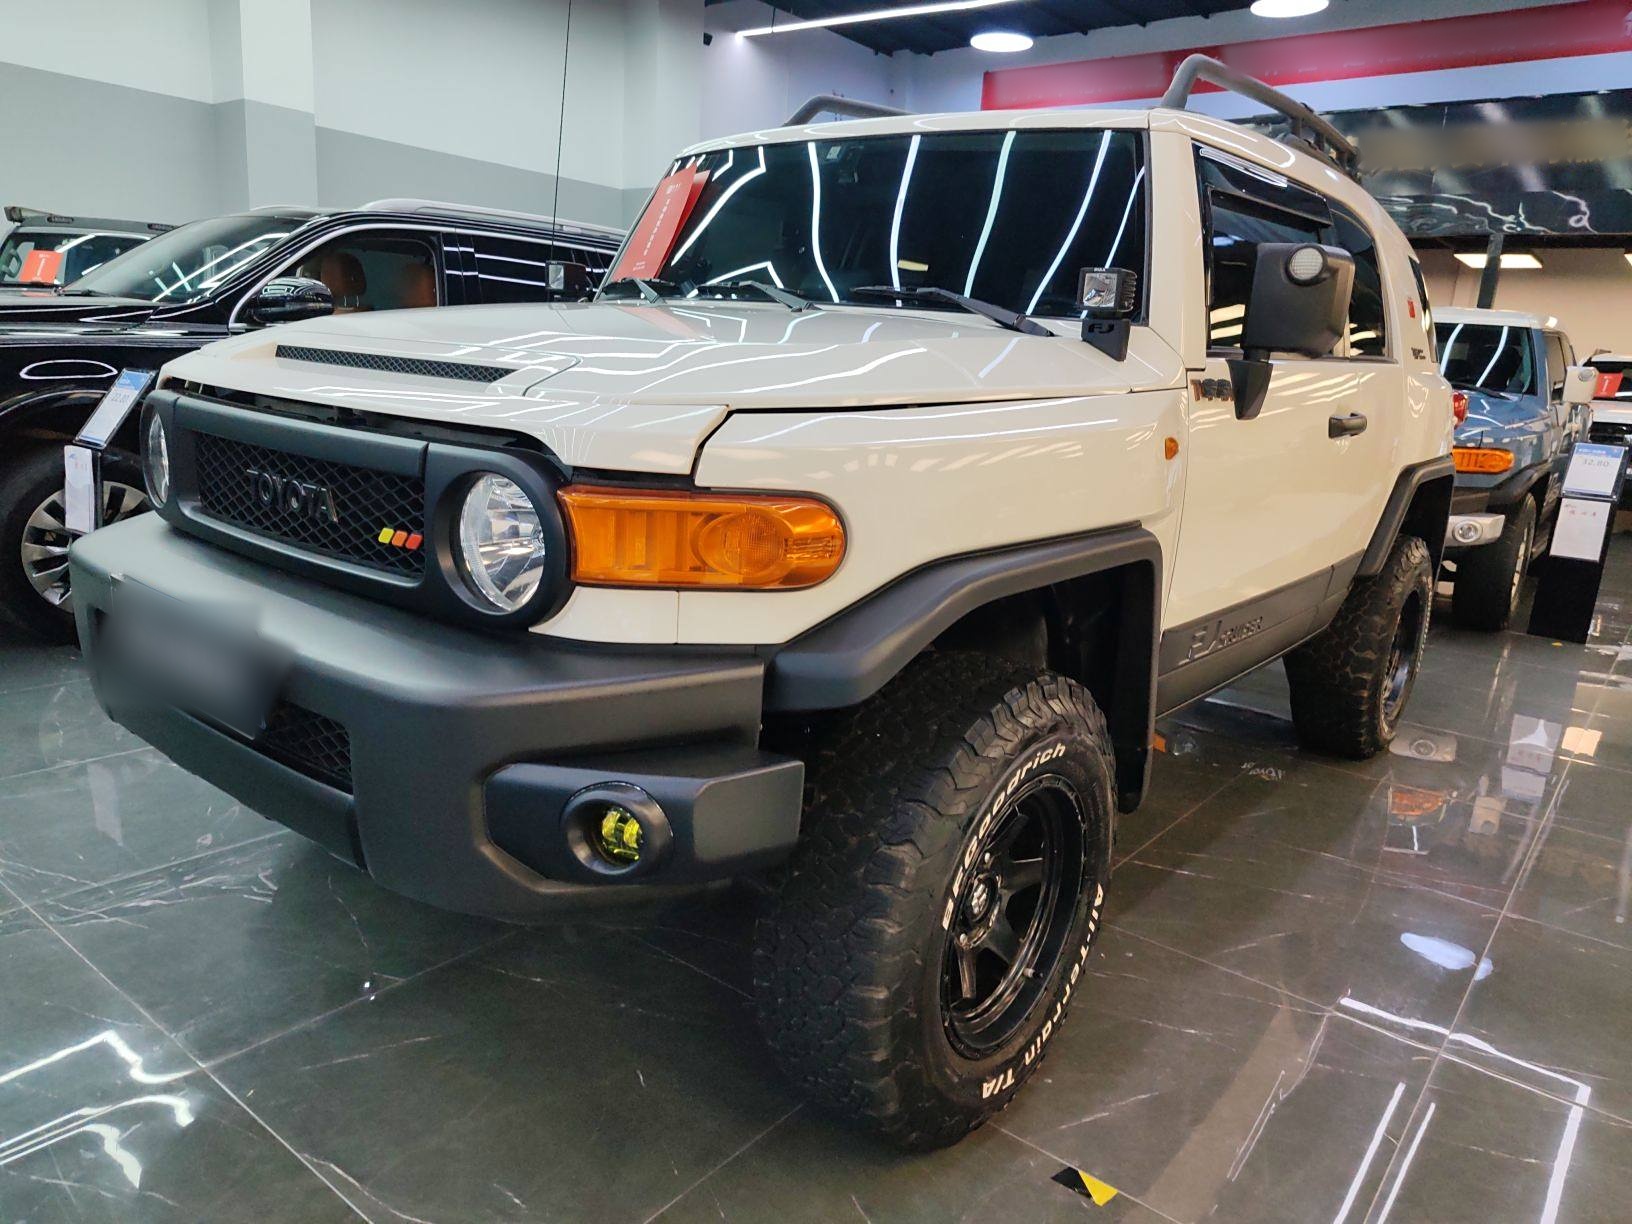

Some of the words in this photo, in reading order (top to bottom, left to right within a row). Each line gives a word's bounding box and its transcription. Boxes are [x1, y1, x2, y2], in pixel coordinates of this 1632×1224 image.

[246, 468, 338, 523] TOYOTA
[942, 742, 1066, 930] BFGoodrich
[1024, 882, 1104, 1066] All-Terrain
[982, 1067, 1015, 1099] T/A
